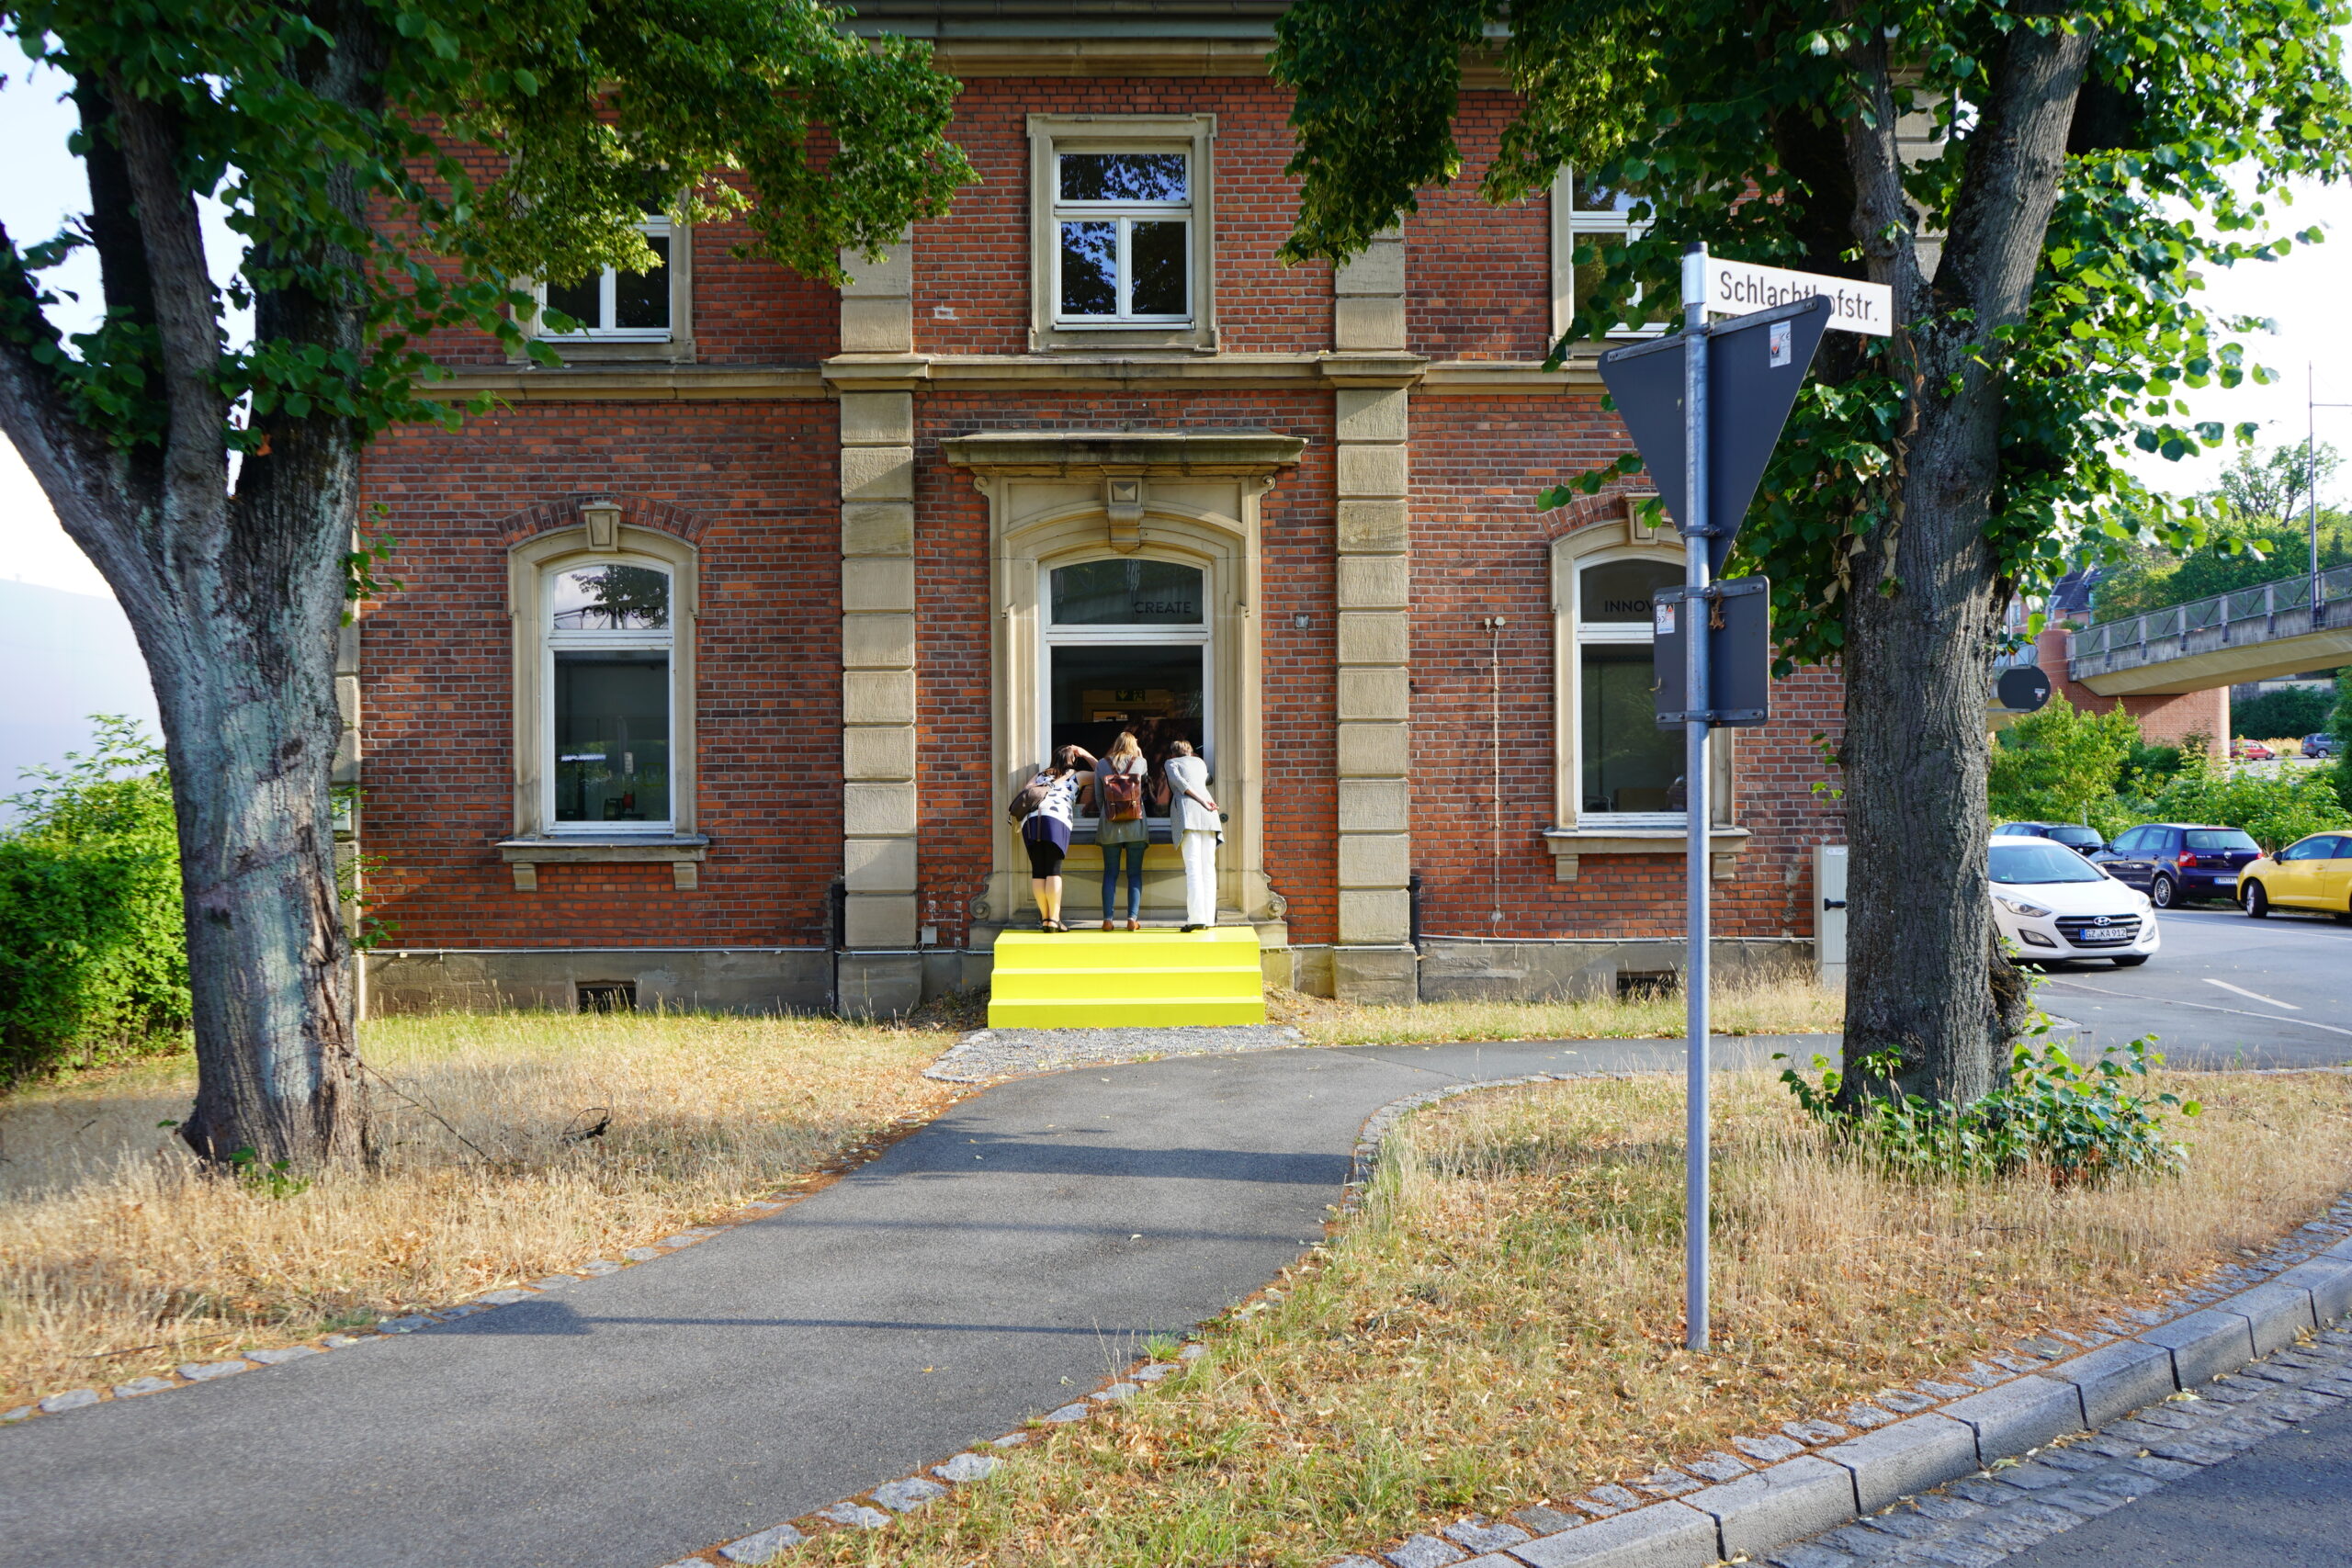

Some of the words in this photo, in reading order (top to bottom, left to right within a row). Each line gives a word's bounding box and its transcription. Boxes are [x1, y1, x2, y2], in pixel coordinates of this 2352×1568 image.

[1720, 270, 1878, 321] Schlachtofstr.
[582, 606, 660, 619] CONNECT
[1134, 601, 1192, 614] CREATE
[1605, 600, 1654, 613] INNOV
[2086, 930, 2096, 938] GZ
[2111, 929, 2126, 937] 912
